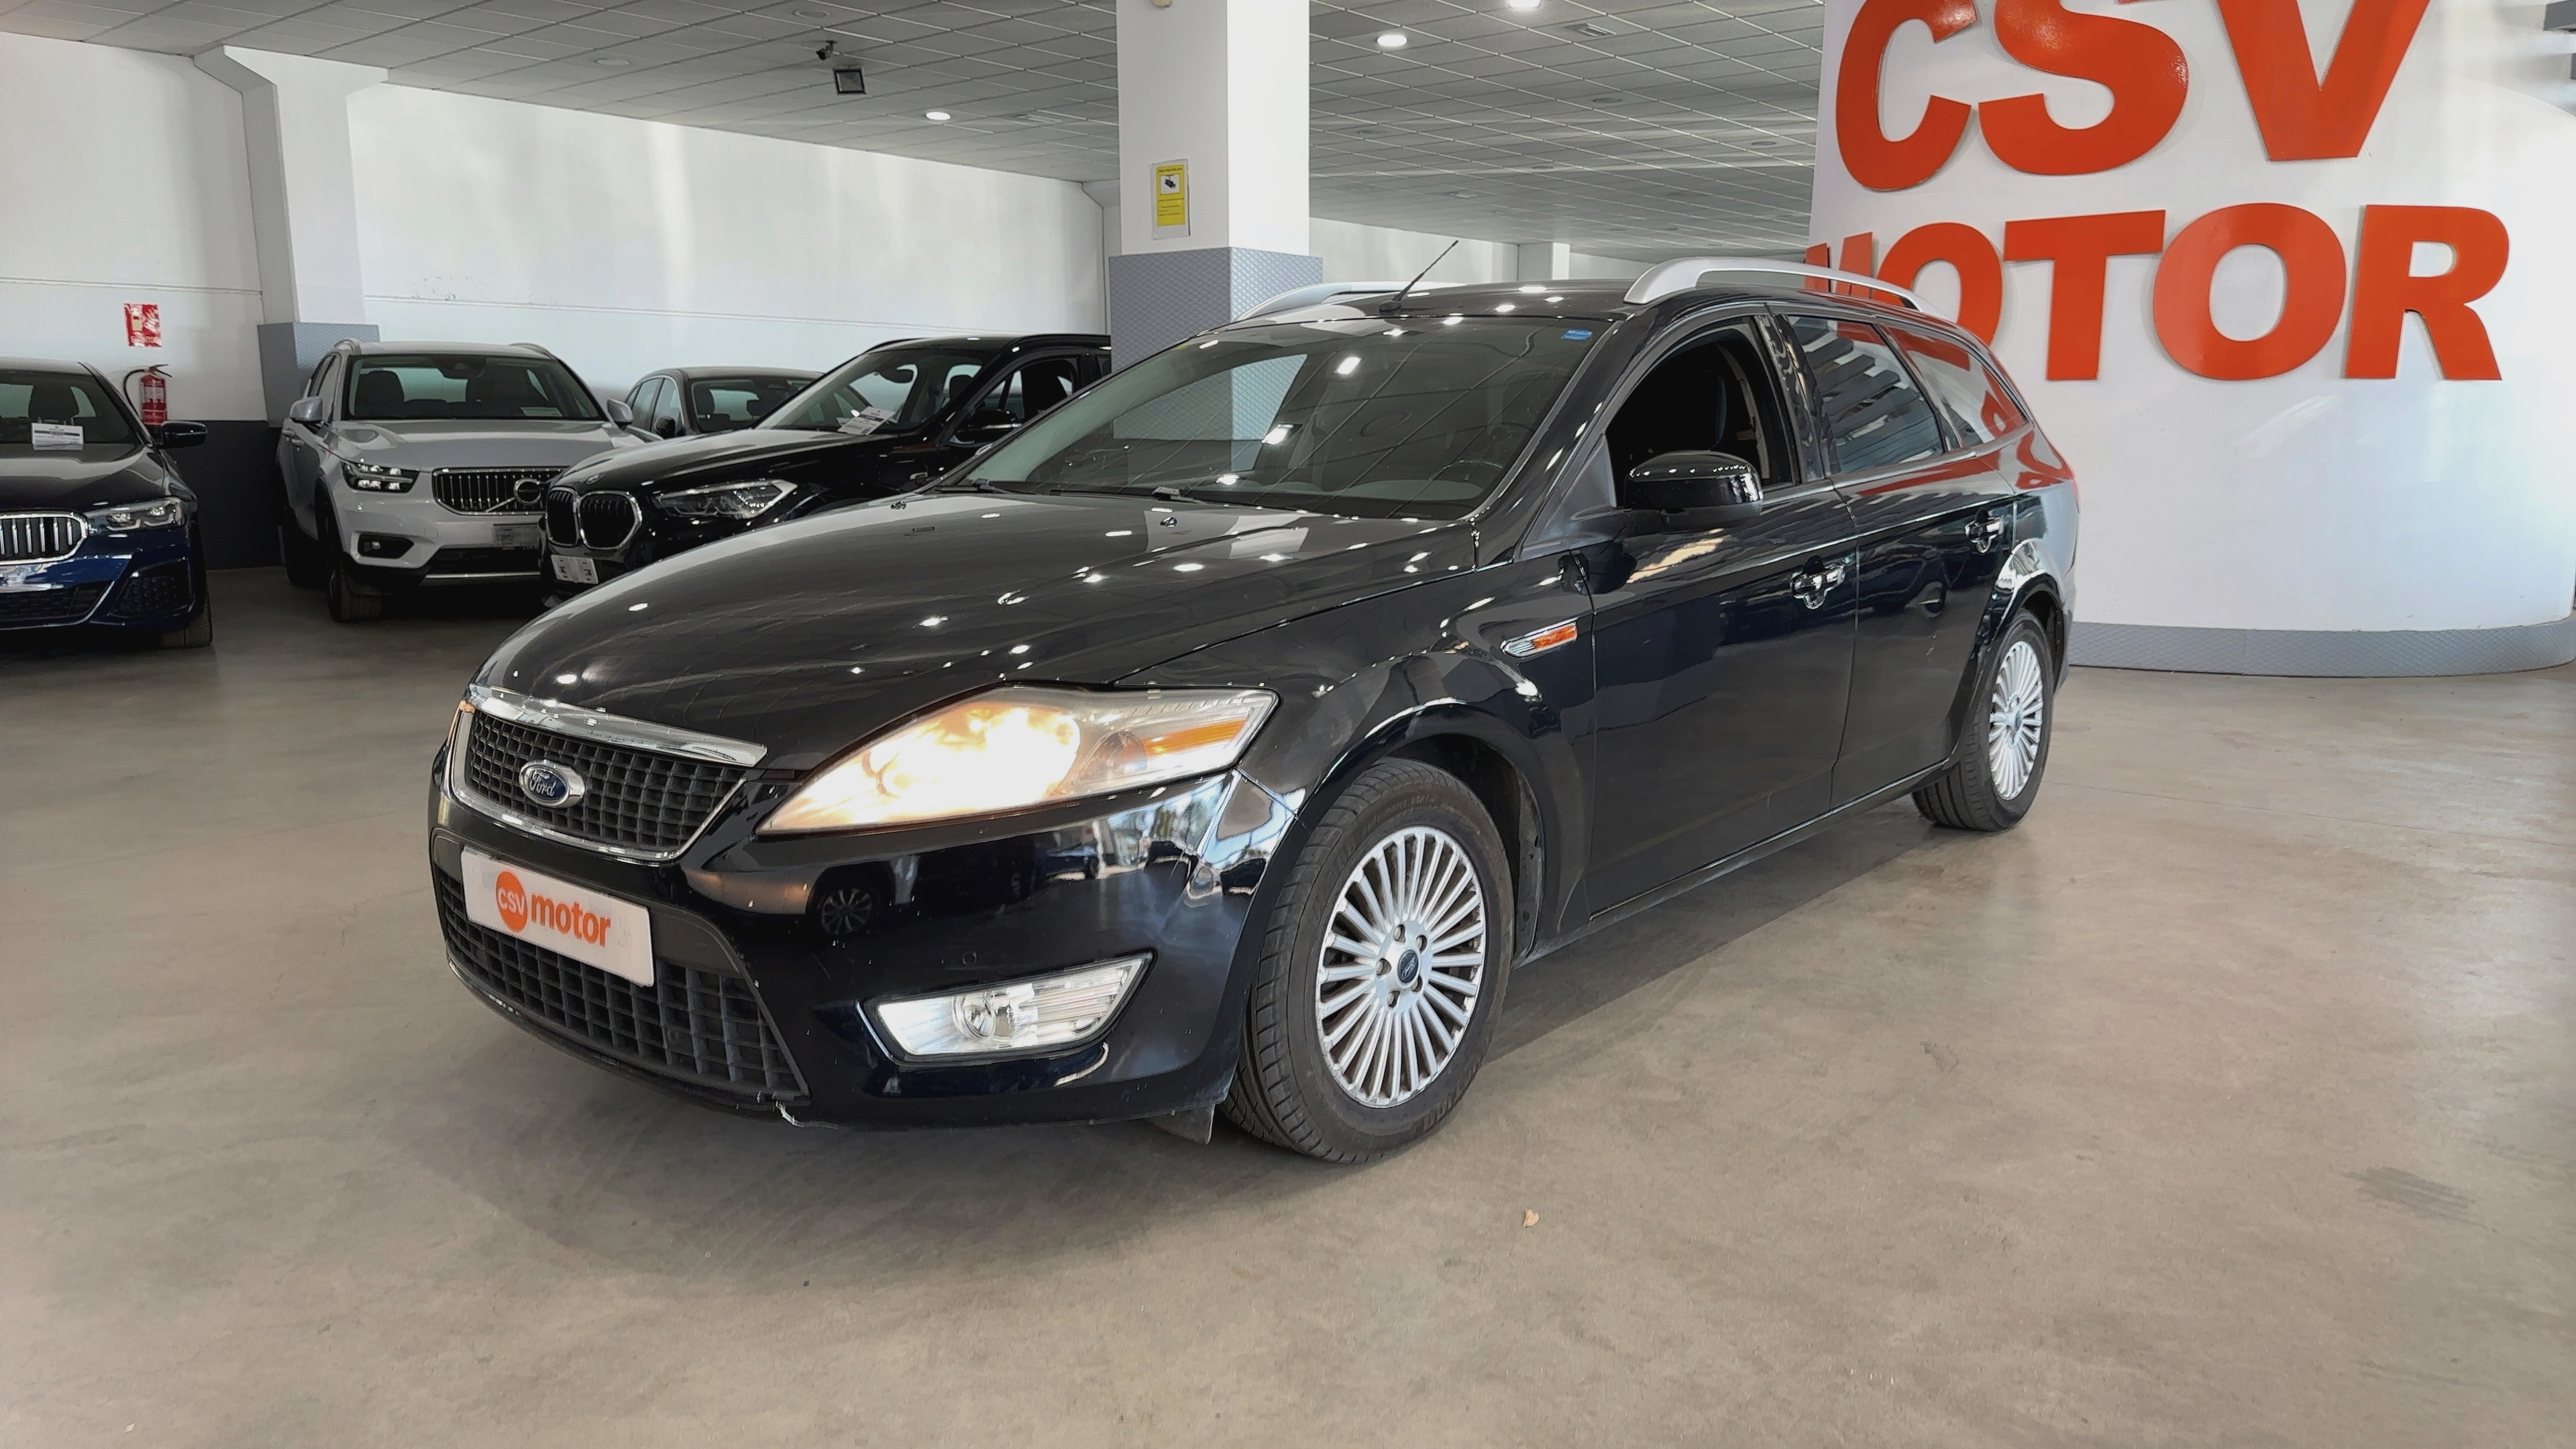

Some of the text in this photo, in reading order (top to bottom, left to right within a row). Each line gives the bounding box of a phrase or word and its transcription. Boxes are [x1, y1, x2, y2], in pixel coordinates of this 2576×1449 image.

[1835, 0, 2426, 191] CSV
[529, 769, 557, 797] Ford
[497, 886, 611, 948] CSV motor
